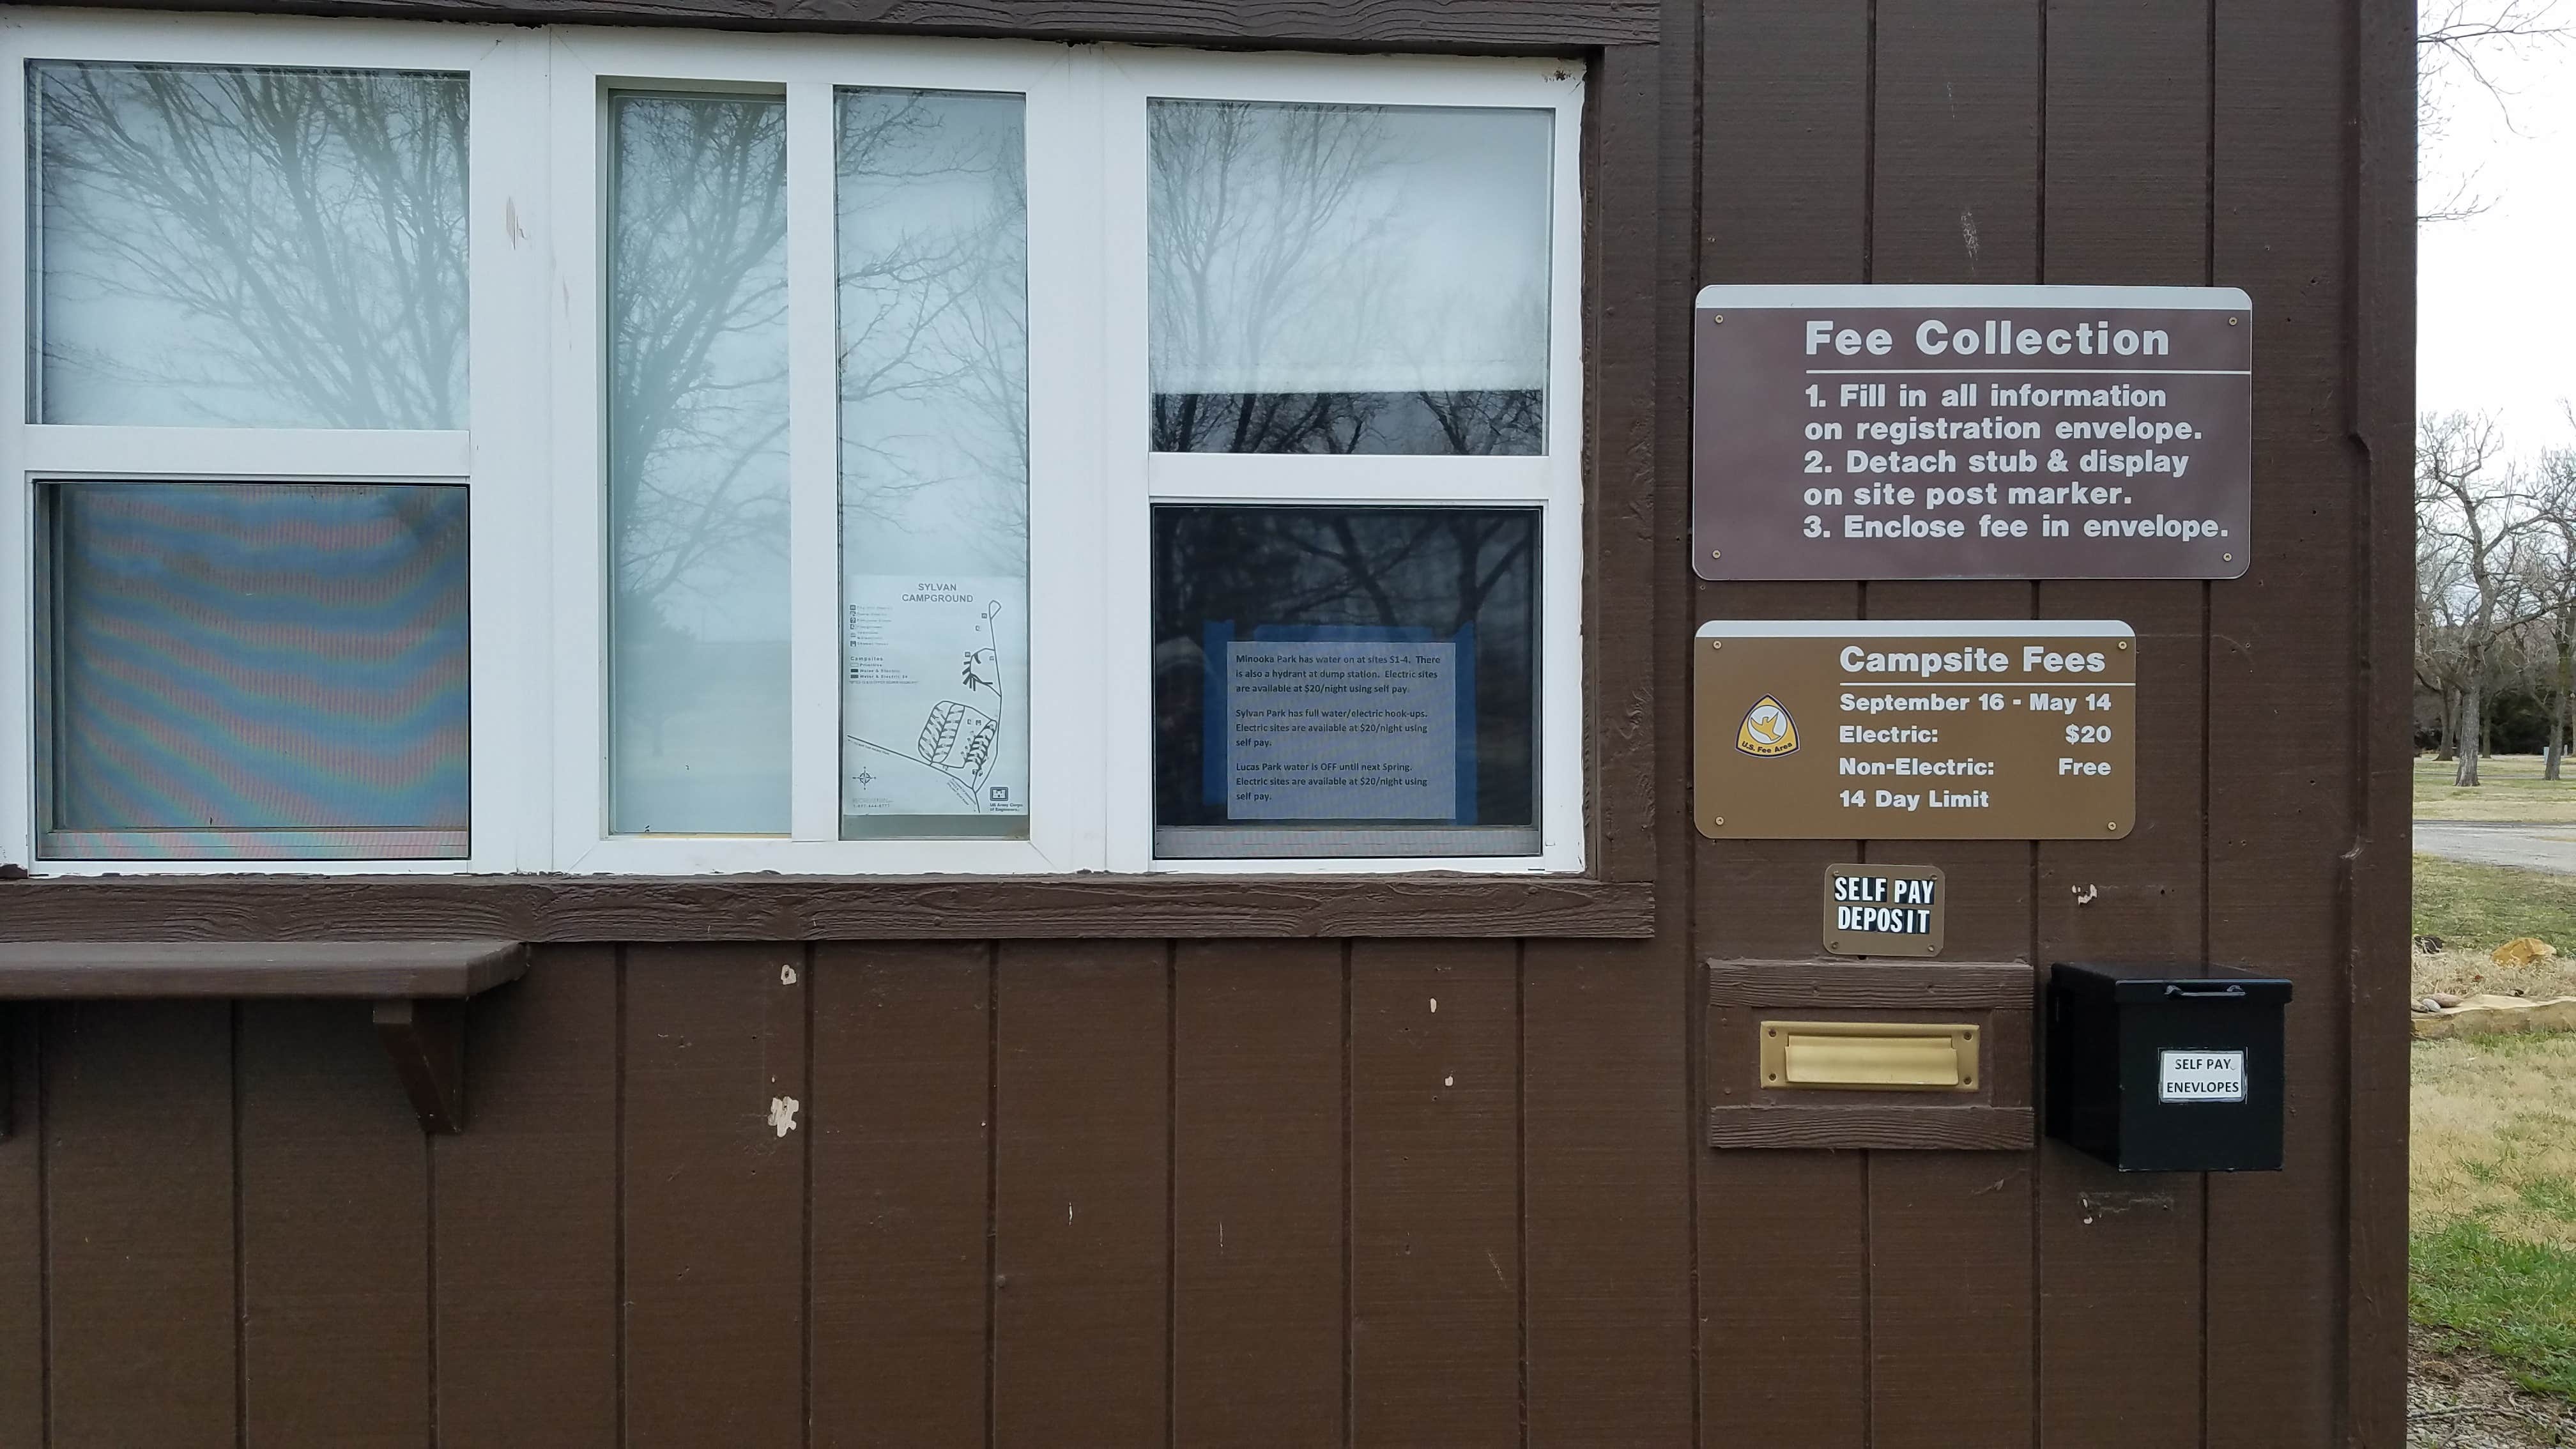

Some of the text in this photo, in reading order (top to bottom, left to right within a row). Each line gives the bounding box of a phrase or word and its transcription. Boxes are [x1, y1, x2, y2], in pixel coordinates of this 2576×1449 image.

[1807, 320, 2168, 355] Fee Collection
[1805, 384, 2165, 407] 1. Fill in all information
[1805, 417, 2201, 445] on registration envelope.
[1804, 449, 2189, 477] 2. Detach stub & display
[1804, 482, 2131, 509] on site post marker.
[1804, 514, 2227, 541] 3. Enclose fee in envelope.
[1236, 655, 1274, 663] Minooka
[1277, 655, 1296, 663] Park
[1299, 655, 1313, 663] has
[1416, 656, 1440, 664] There
[1841, 646, 2104, 677] Campsite Fees
[1236, 670, 1243, 678] is
[1245, 670, 1262, 678] also
[1272, 670, 1306, 680] hydrant
[1320, 670, 1344, 680] dump
[1347, 670, 1380, 678] station.
[1385, 670, 1416, 678] Electric
[1418, 670, 1438, 678] sites
[1252, 684, 1291, 693] available
[1305, 684, 1347, 694] $20/night
[1349, 685, 1372, 694] using
[1374, 684, 1389, 693] self
[1840, 694, 1970, 714] September
[1979, 694, 2004, 710] 16
[2030, 694, 2076, 714] May
[2086, 694, 2111, 710] 14
[1236, 709, 1427, 719] Sylvan Park has full water/electric hook-ups.
[1236, 724, 1268, 732] Electric
[1269, 724, 1290, 732] sites
[1308, 723, 1346, 732] available
[1360, 723, 1402, 734] $20/night
[1405, 724, 1427, 734] using
[1840, 724, 2111, 744] Electric: $20
[1236, 739, 1271, 749] self pay.
[1742, 741, 1755, 751] U.S.
[1775, 742, 1792, 752] Area
[1236, 763, 1259, 771] Lucas
[1262, 763, 1281, 771] Park
[1339, 763, 1359, 771] until
[1383, 763, 1412, 773] Spring.
[1840, 758, 2111, 775] Non-Electric: Free
[1236, 778, 1268, 786] Electric
[1269, 778, 1290, 786] sites
[1308, 777, 1346, 786] available
[1360, 777, 1402, 788] $20/night
[1405, 778, 1427, 788] using
[1236, 792, 1271, 802] self pay.
[1840, 790, 1988, 811] 14 Day Limit
[1835, 877, 1934, 903] SELF PAY
[1838, 906, 1929, 933] DEPOSIT
[2175, 1059, 2202, 1070] SELF
[2167, 1082, 2239, 1092] ENEVLOPES
